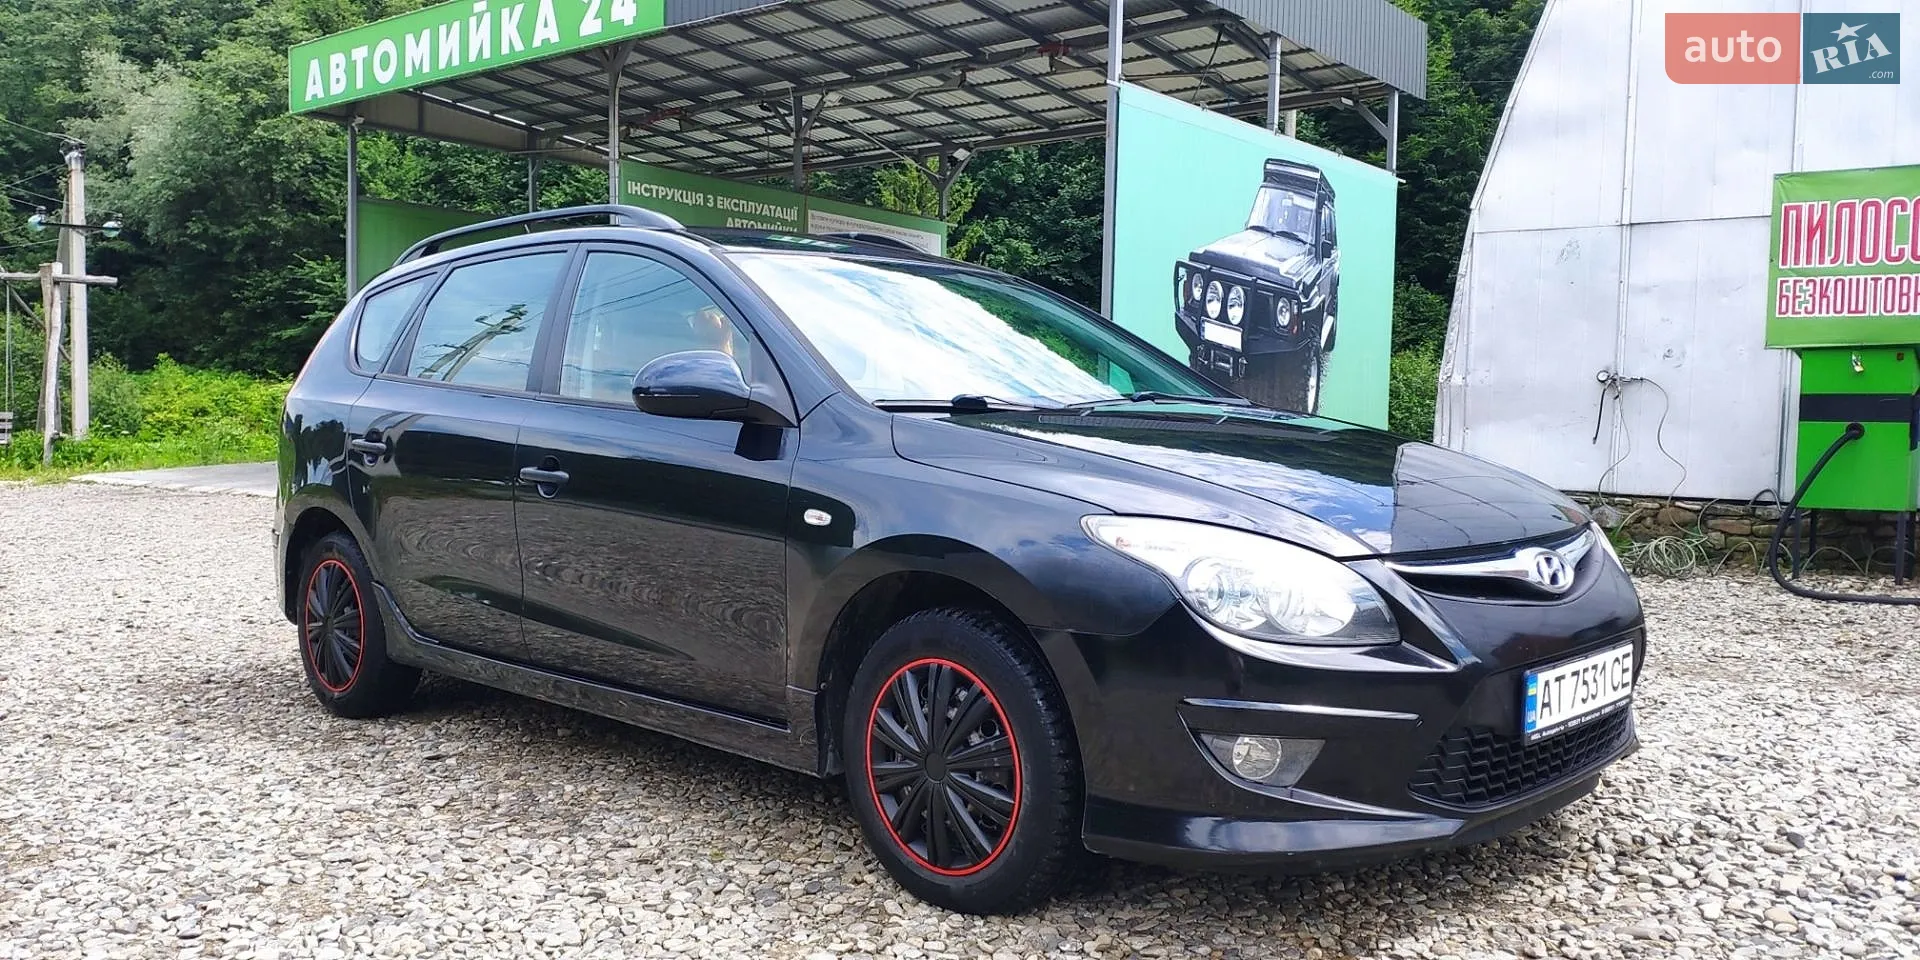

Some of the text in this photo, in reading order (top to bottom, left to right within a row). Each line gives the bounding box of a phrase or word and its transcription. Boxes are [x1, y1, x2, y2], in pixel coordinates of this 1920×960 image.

[305, 0, 637, 102] АВТОМИЙКА 24
[627, 181, 704, 205] ІНСТРУКЦІЯ
[717, 196, 799, 222] ЕКСПЛУАТАЦІЇ
[1540, 675, 1566, 720] AT
[1571, 661, 1607, 709] 7531
[1611, 652, 1631, 692] CE
